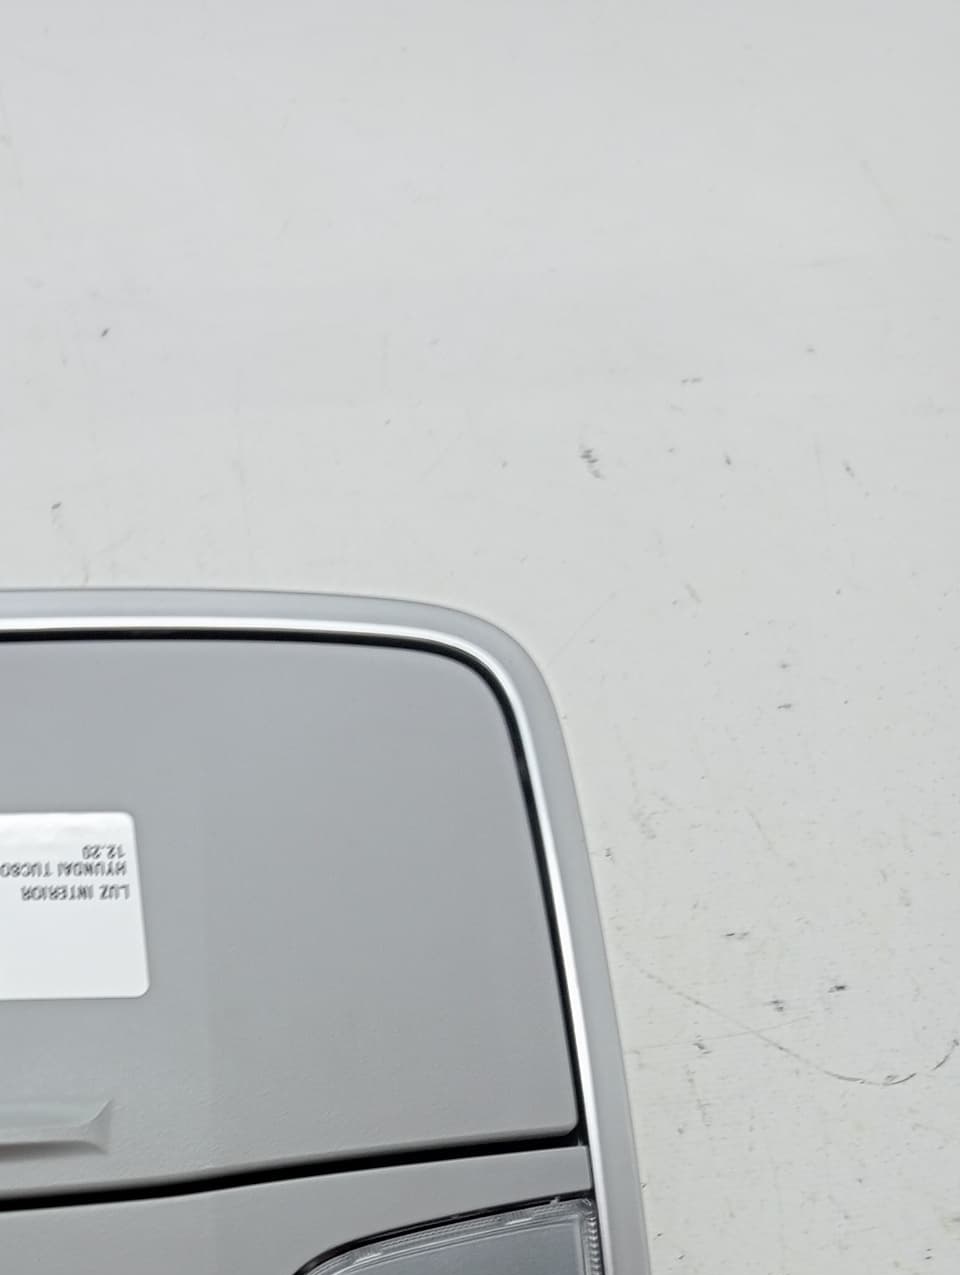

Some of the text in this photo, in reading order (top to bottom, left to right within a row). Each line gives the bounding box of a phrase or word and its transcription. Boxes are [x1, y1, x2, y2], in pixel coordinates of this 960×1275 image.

[56, 860, 128, 877] HYUNDAI
[20, 883, 131, 901] LUZ INTERIOR
